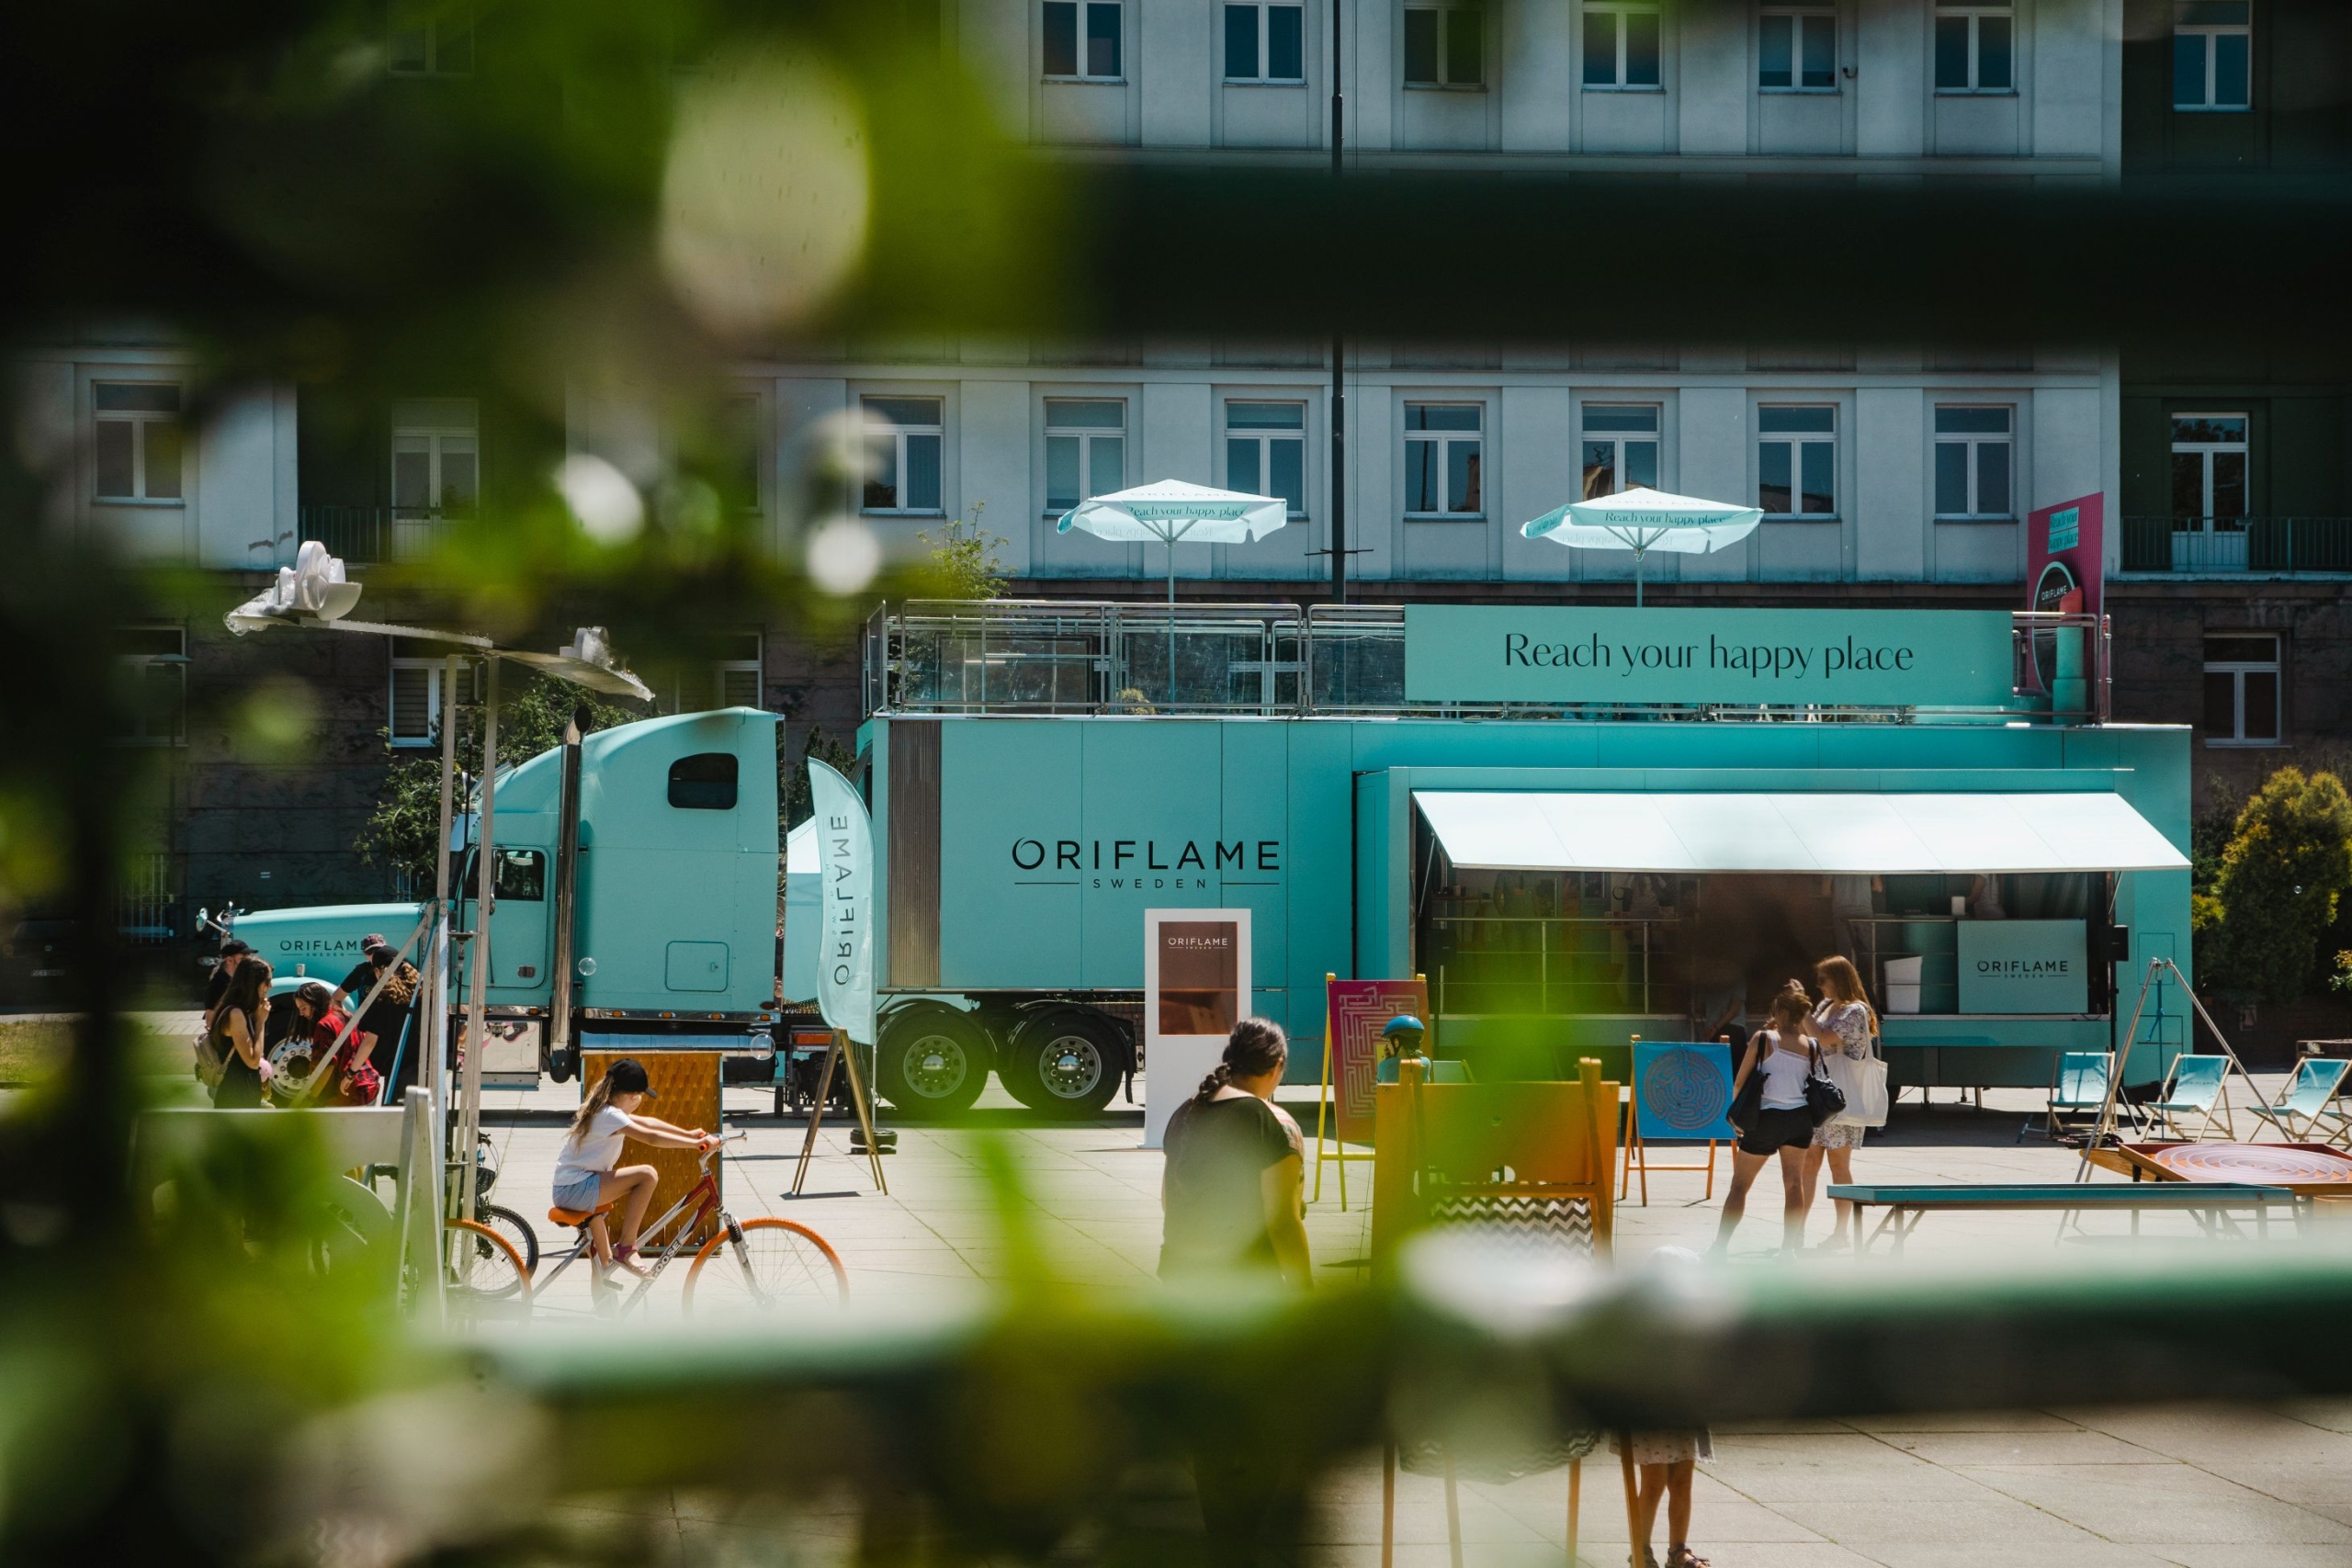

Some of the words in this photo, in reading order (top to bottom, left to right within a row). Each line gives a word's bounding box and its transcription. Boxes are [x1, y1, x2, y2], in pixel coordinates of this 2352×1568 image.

[1160, 507, 1182, 517] your
[1185, 505, 1216, 517] happy
[1605, 512, 1637, 523] Reach
[1639, 514, 1663, 524] your
[1664, 513, 1696, 526] happy
[2041, 585, 2067, 600] ORIFLAME
[1505, 632, 1611, 668] Reach
[1622, 644, 1699, 677] your
[1710, 634, 1814, 679] happy
[1825, 635, 1914, 679] place
[1012, 837, 1280, 870] ORIFLAME
[1093, 878, 1206, 888] SWEDEN
[1168, 937, 1227, 945] ORIFLAME
[1977, 960, 2068, 972] ORIFLAME
